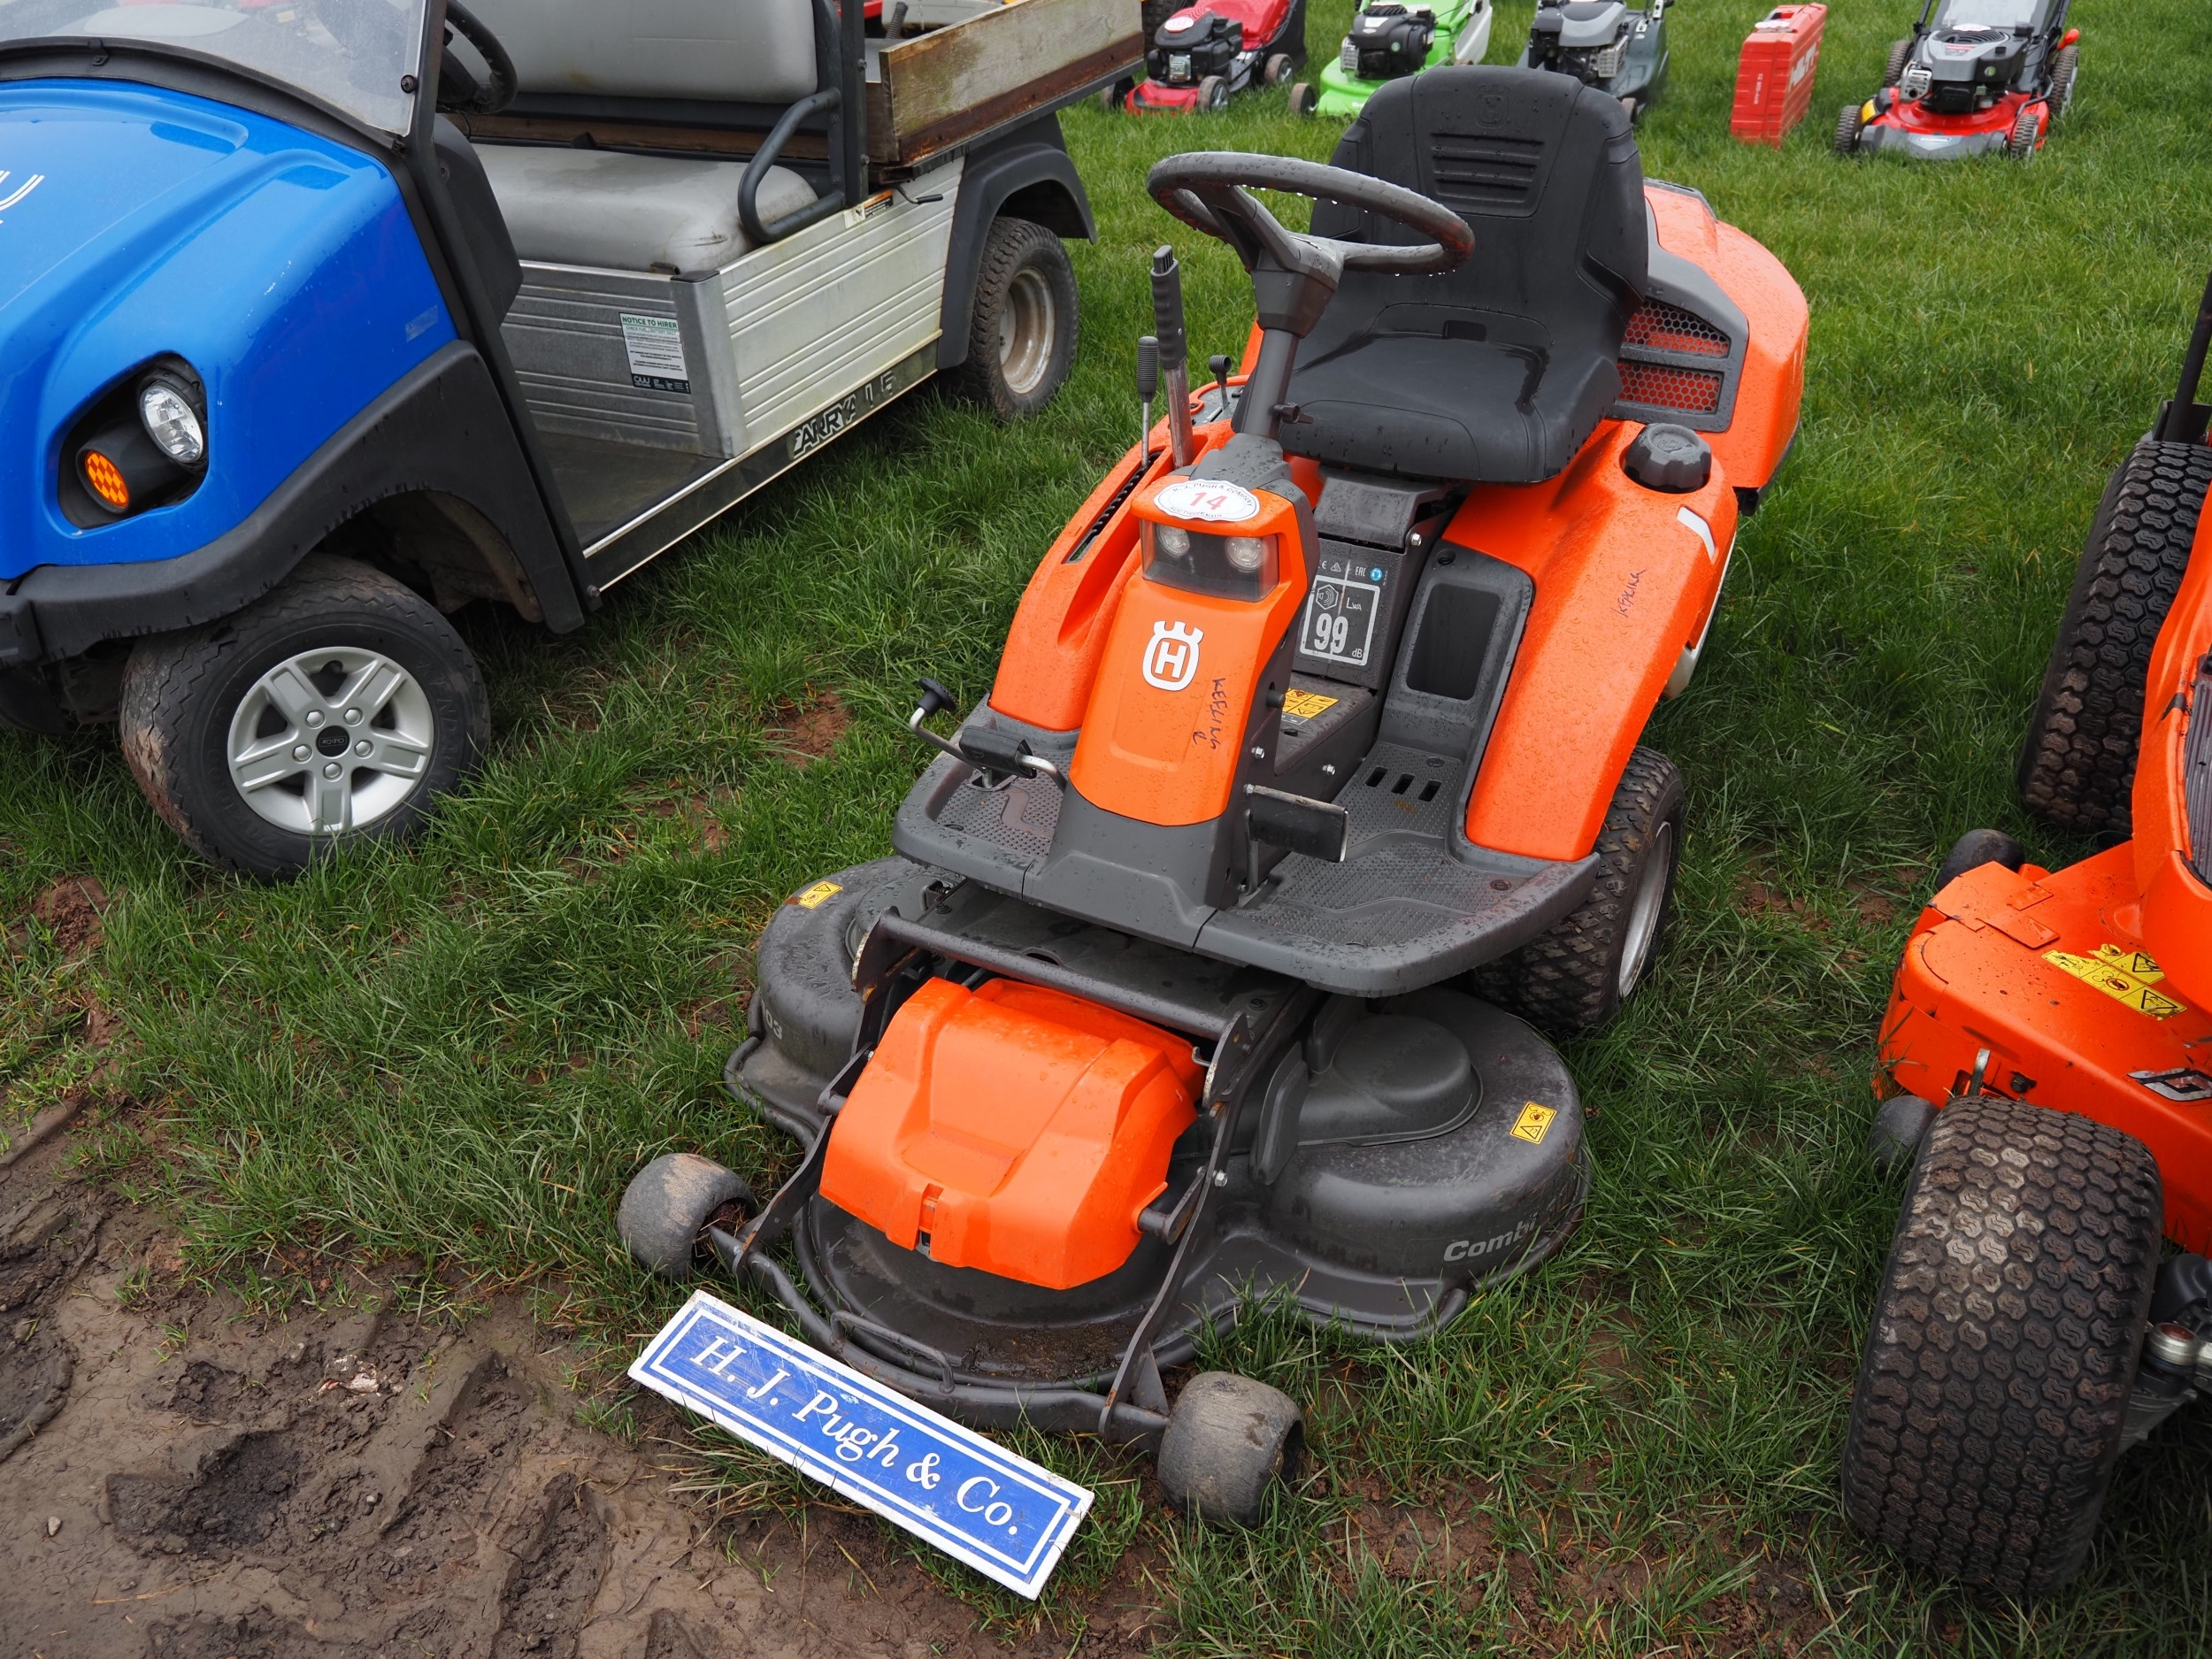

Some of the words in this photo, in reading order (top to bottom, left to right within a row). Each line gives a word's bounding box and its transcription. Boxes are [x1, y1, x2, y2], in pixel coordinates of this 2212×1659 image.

[622, 316, 646, 326] NOTICE
[1189, 492, 1228, 511] 14
[1226, 488, 1254, 507] COMPANY
[1314, 612, 1348, 654] 99
[1351, 648, 1363, 658] dB
[1443, 1211, 1539, 1262] Combi
[689, 1334, 747, 1382] H.
[746, 1368, 791, 1406] J.
[792, 1390, 900, 1469] Pugh
[905, 1452, 941, 1490] &
[956, 1475, 1019, 1535] Co.
